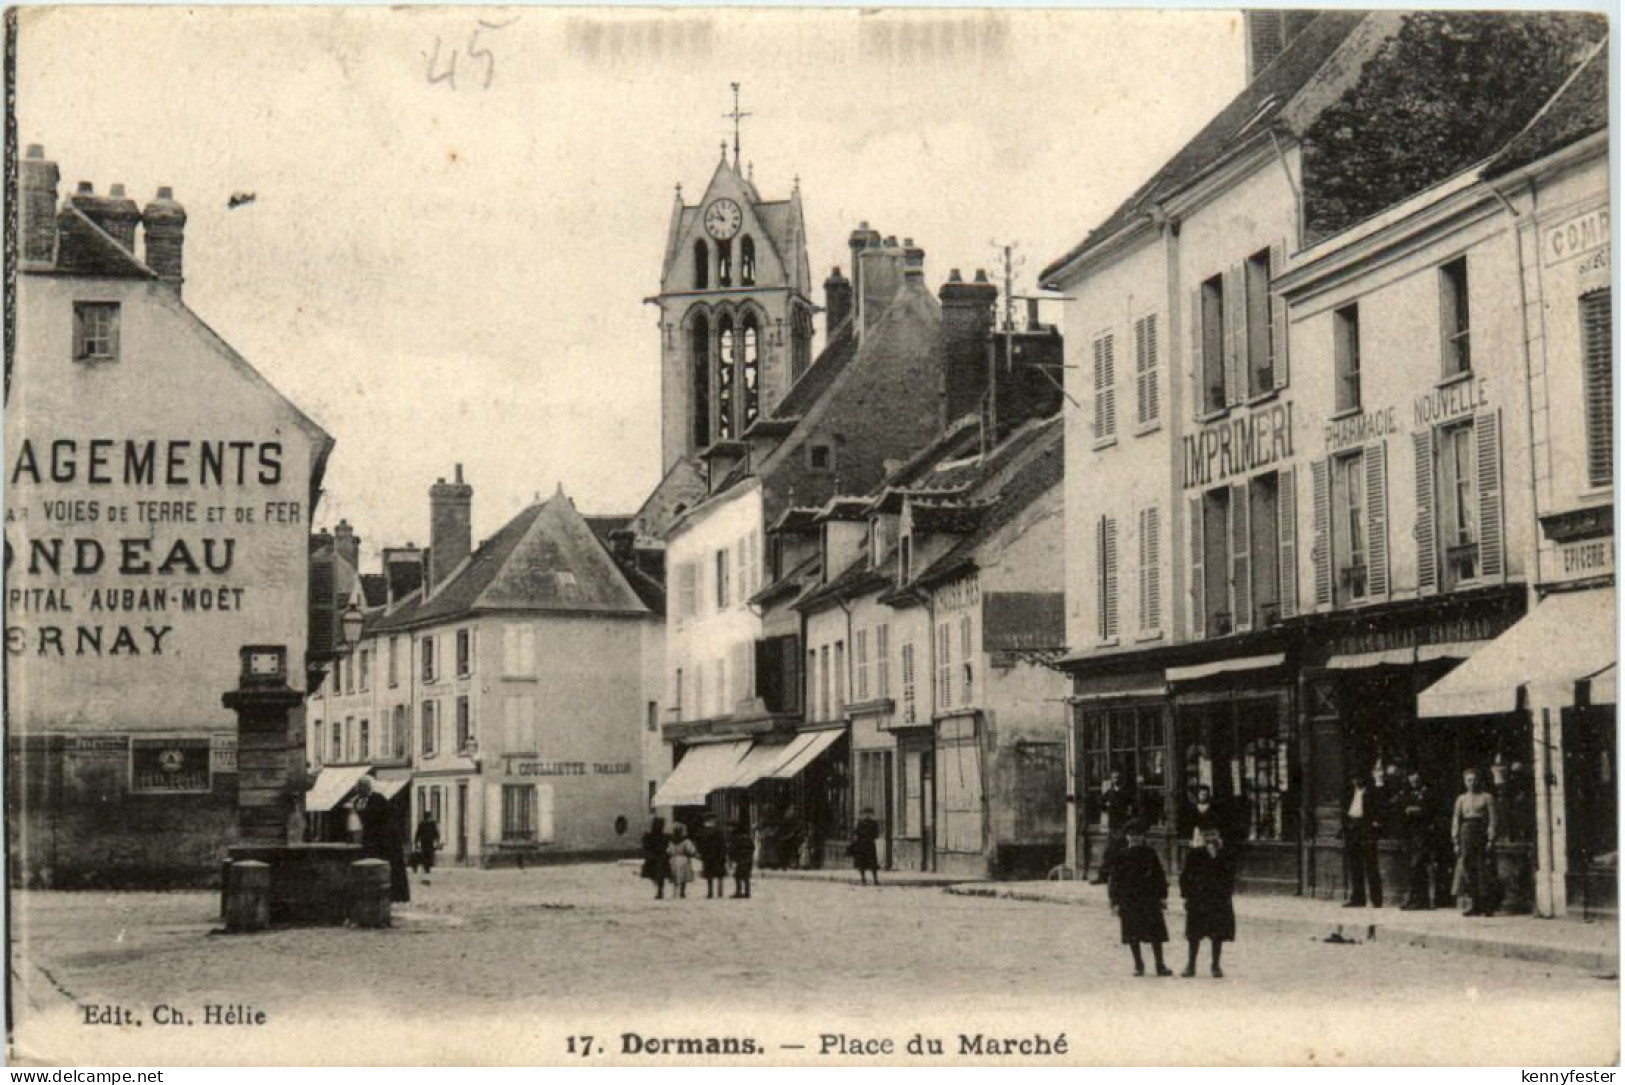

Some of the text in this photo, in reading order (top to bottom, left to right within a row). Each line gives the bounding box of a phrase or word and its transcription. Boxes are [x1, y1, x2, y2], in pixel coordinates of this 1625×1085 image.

[1325, 377, 1488, 451] PHARMACIE NOUVELLE
[11, 438, 283, 486] AGEMENTS
[1183, 400, 1294, 489] IMPRIMERI
[43, 500, 100, 521] VOIES
[107, 506, 128, 521] DE
[137, 501, 197, 522] TERRE
[206, 507, 225, 522] ET
[235, 507, 254, 522] DE
[264, 501, 301, 524] FER
[9, 588, 73, 612] PITAL
